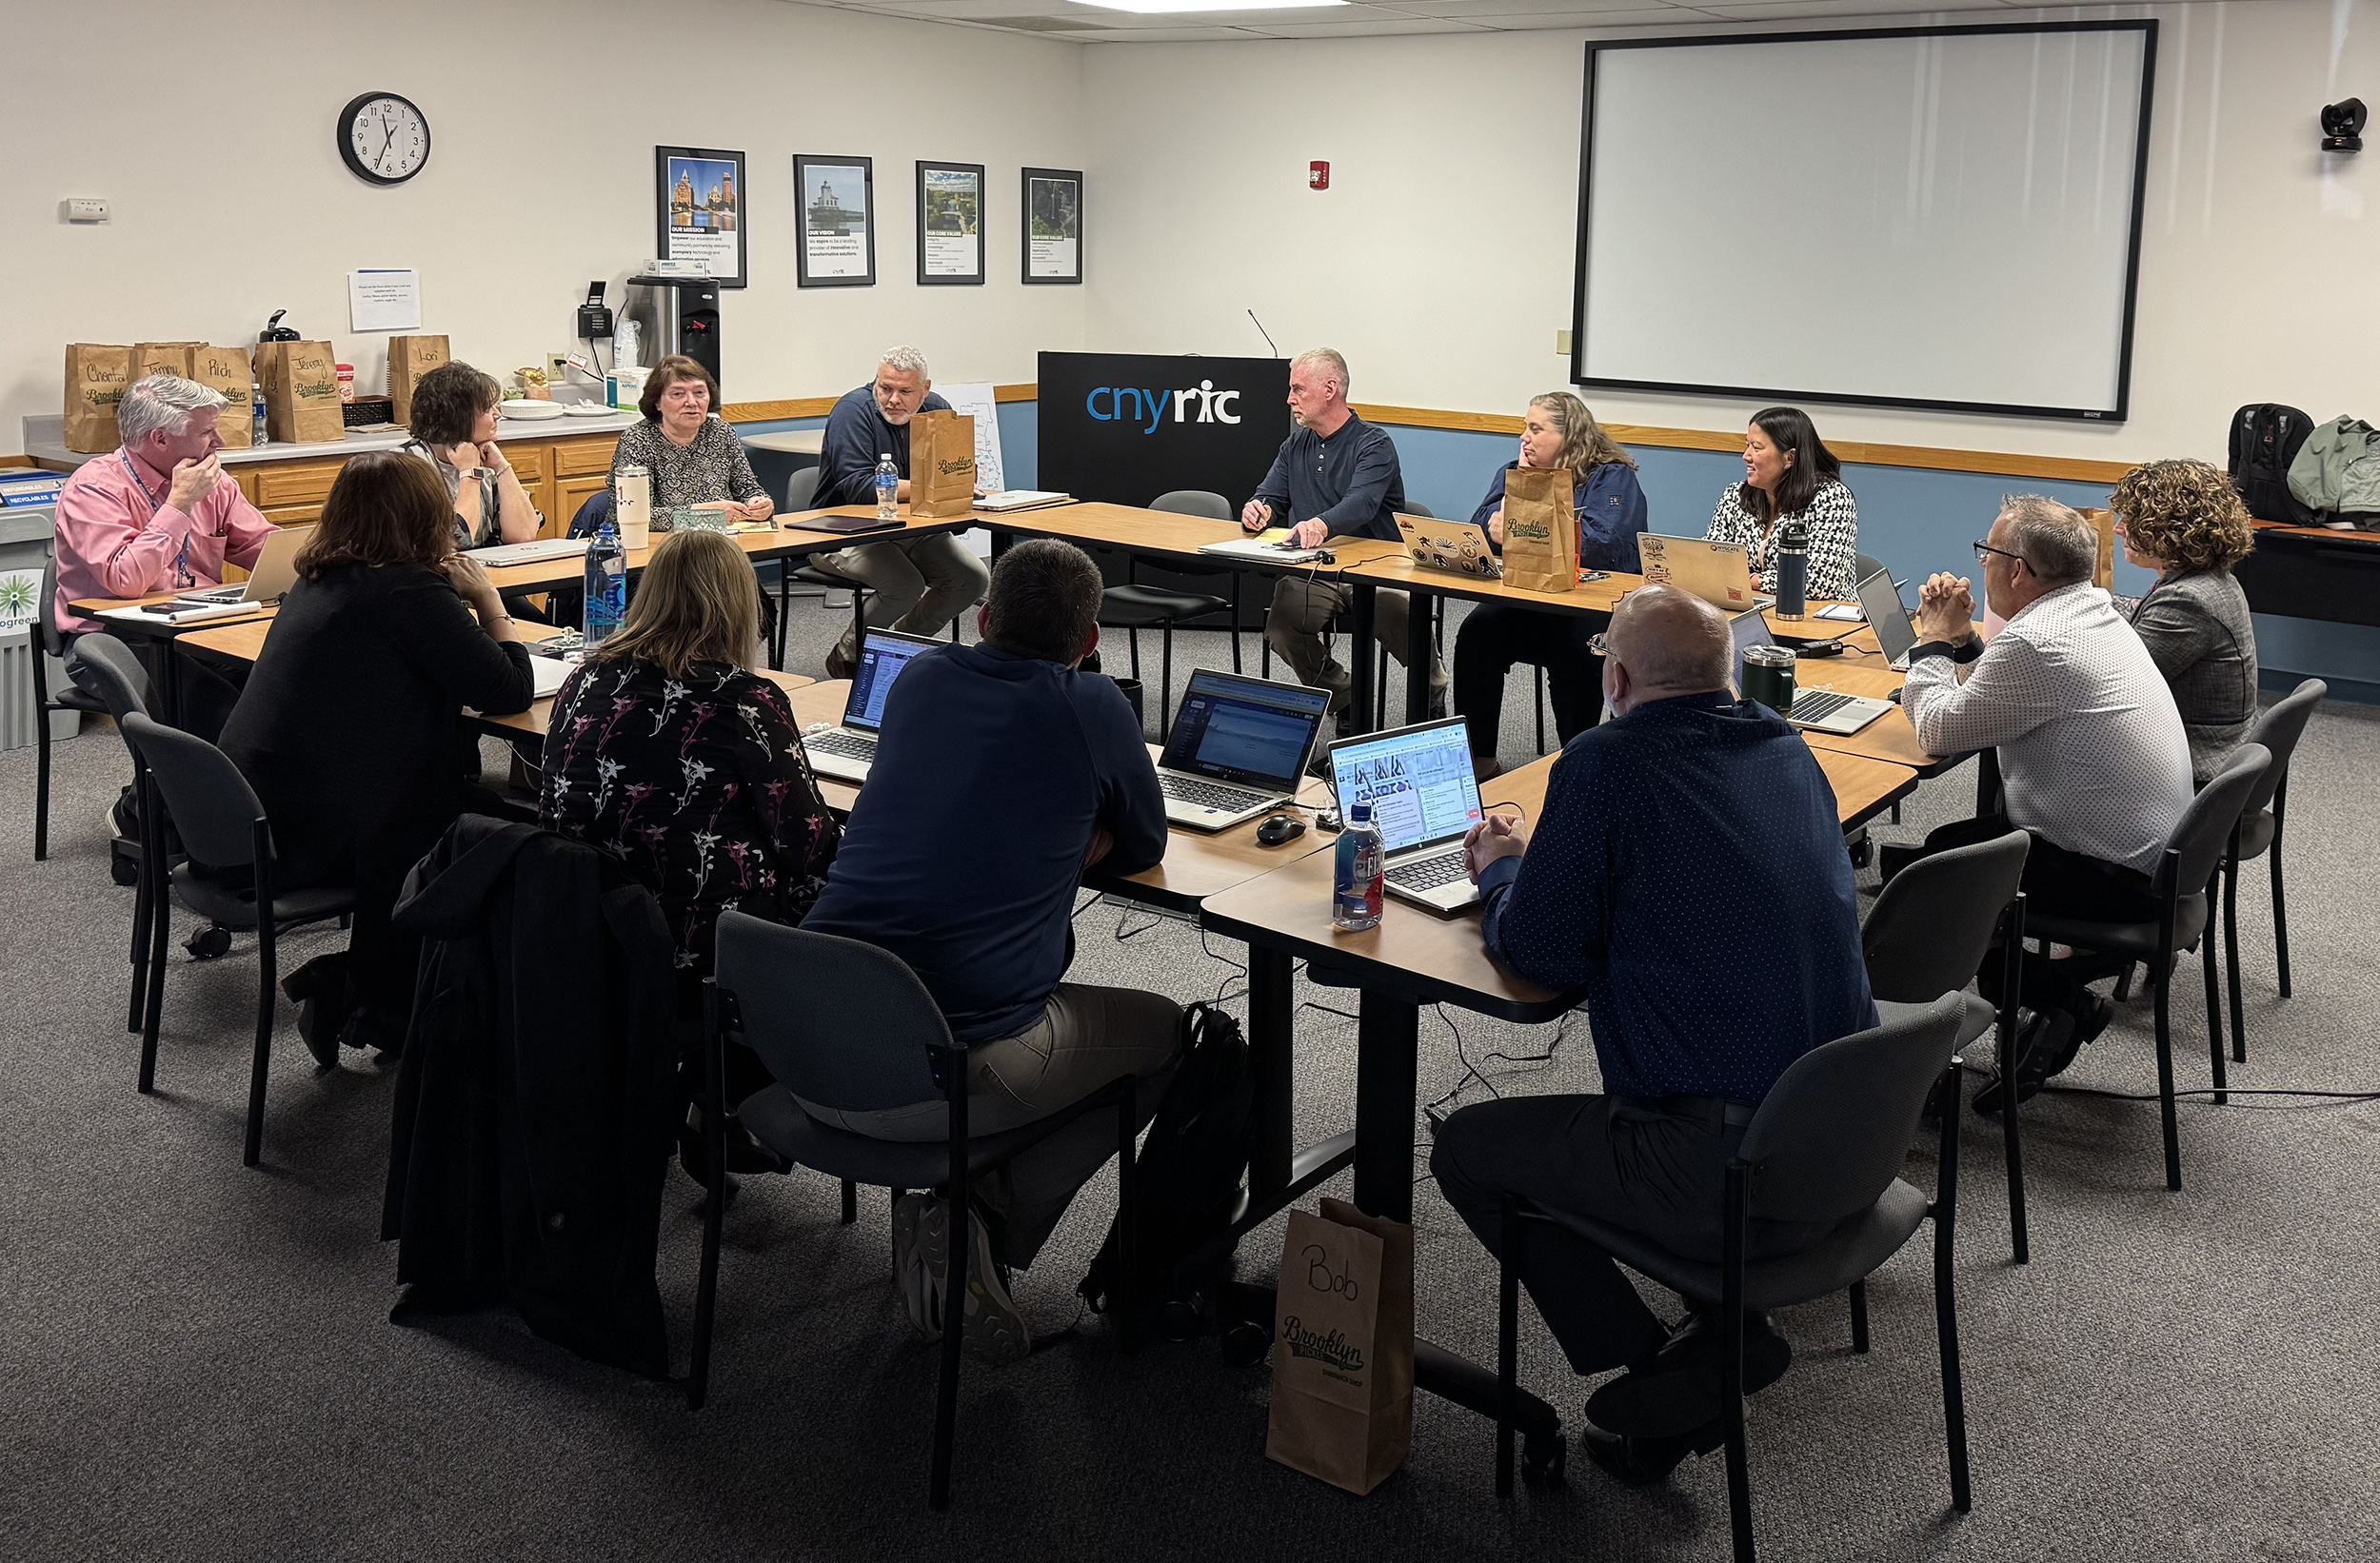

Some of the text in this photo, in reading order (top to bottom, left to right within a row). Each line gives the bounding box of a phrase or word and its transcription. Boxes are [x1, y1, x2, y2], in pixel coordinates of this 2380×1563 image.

[370, 108, 377, 116] 11
[384, 104, 392, 113] 12
[401, 109, 405, 119] 1
[360, 118, 369, 128] 10
[410, 122, 417, 130] 2
[357, 132, 364, 141] 9
[413, 137, 419, 146] 3
[362, 147, 367, 155] 8
[409, 149, 415, 158] 4
[386, 163, 392, 172] 6
[401, 160, 407, 169] 5
[417, 347, 438, 362] Lori
[208, 359, 231, 379] Rich
[294, 380, 336, 396] Brooklyn
[86, 387, 126, 401] Brookl
[219, 386, 248, 403] oklyn
[1086, 379, 1241, 435] cnyric
[938, 456, 973, 470] Brooklyn
[2, 485, 44, 493] REFUNDABLES
[10, 494, 50, 504] RECYCLABLES
[1507, 518, 1551, 539] Brooklyn
[0, 616, 38, 628] ogreen
[1300, 1244, 1359, 1301] Bob
[1281, 1316, 1364, 1371] Brooklyn
[1299, 1344, 1324, 1359] PICKLE
